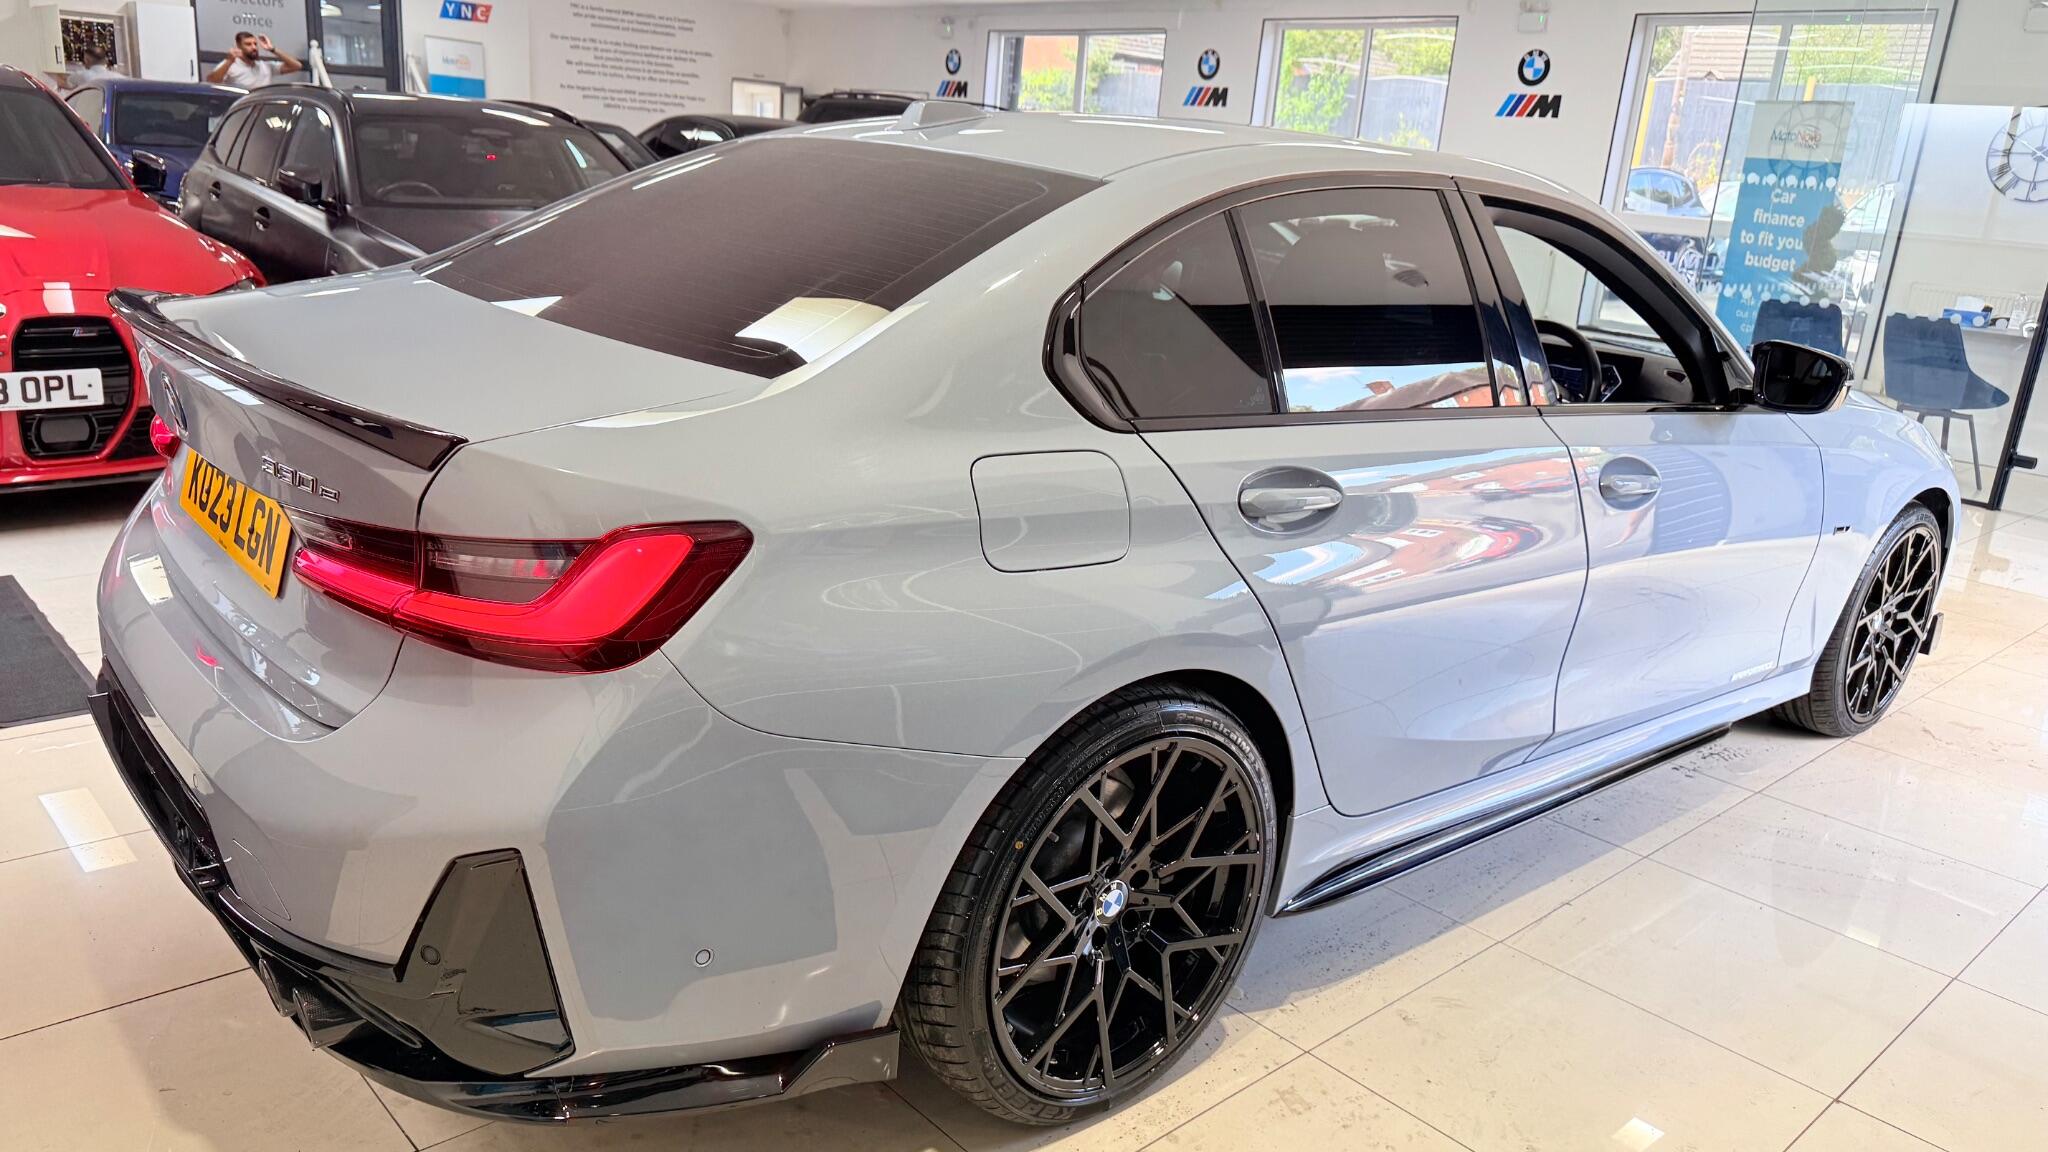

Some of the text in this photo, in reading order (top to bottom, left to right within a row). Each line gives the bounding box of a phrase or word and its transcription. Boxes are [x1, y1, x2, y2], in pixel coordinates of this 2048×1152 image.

[444, 2, 488, 20] YNC
[1770, 187, 1797, 205] Car
[1753, 207, 1805, 228] finance
[1740, 228, 1803, 251] to fit you
[1744, 250, 1797, 272] budget
[20, 374, 88, 404] OPL
[261, 455, 340, 504] 330e
[233, 486, 281, 576] LGN
